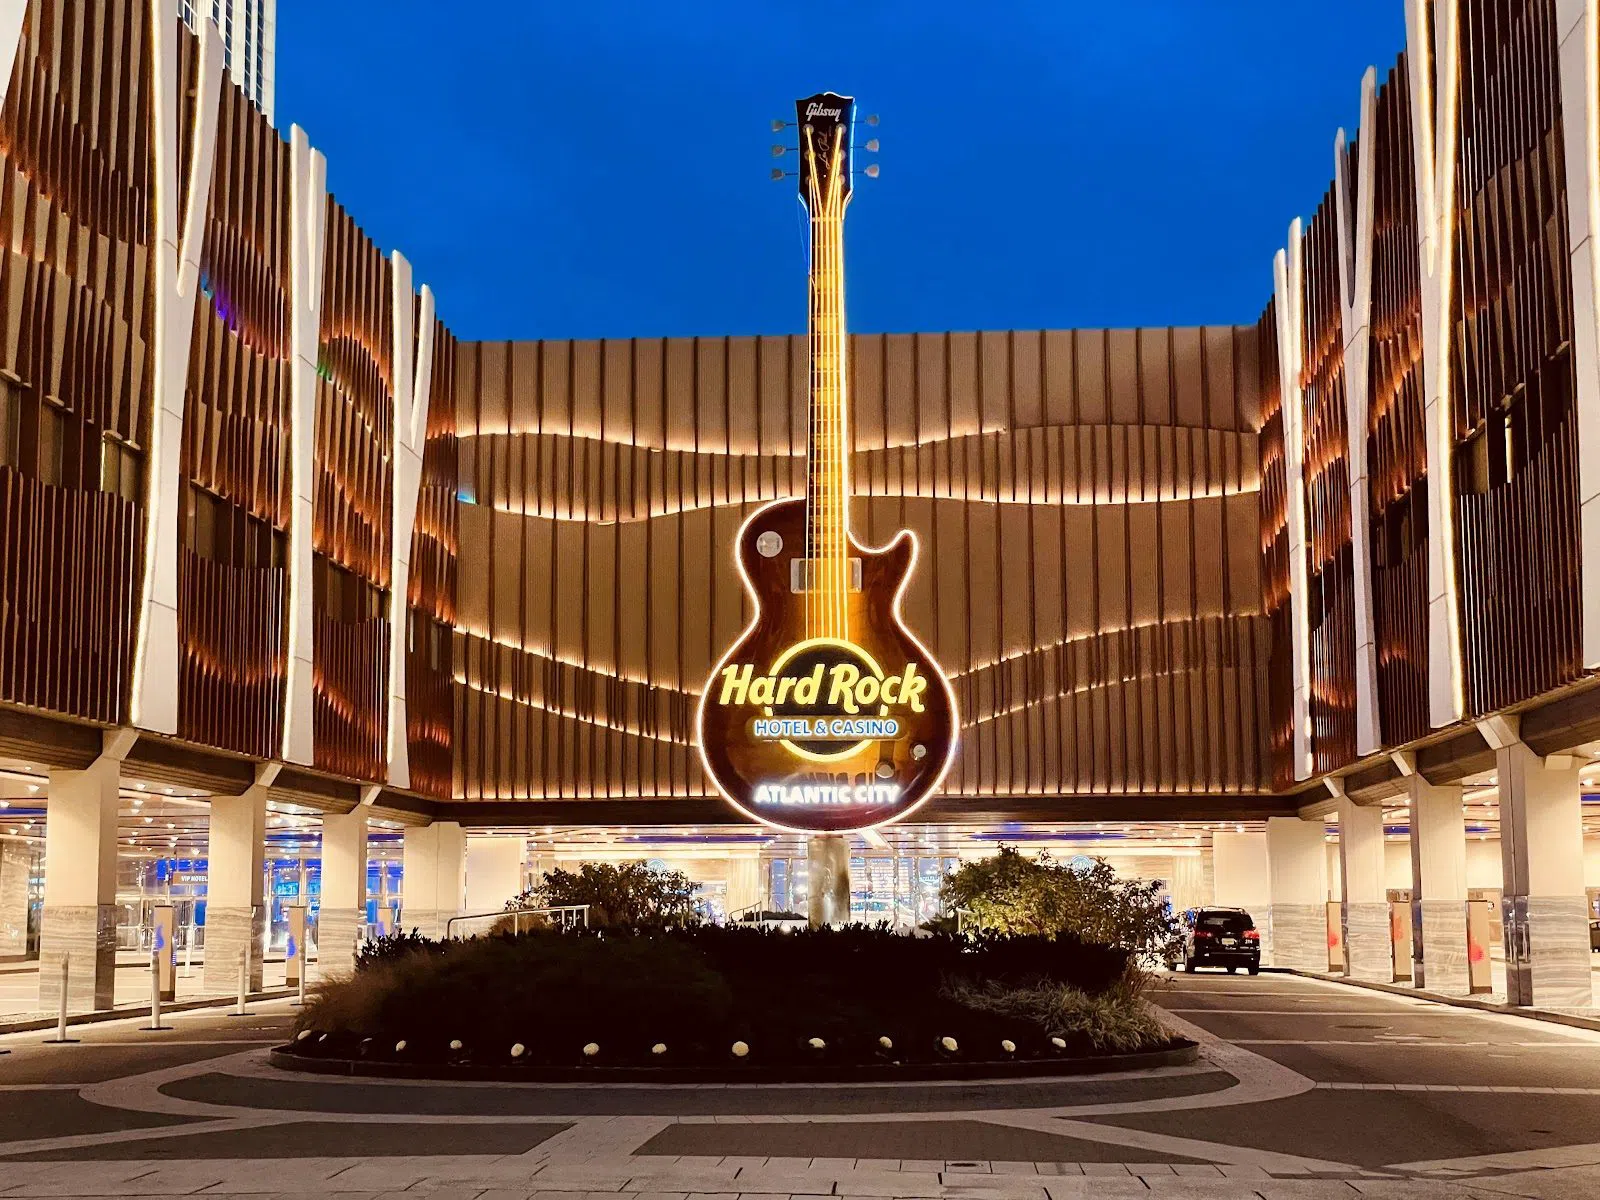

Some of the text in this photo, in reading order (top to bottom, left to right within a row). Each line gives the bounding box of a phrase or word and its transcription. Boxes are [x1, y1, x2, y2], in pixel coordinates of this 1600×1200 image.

[806, 103, 841, 122] Gibson
[719, 663, 927, 713] Hard Rock
[755, 720, 898, 736] HOTEL & CASINO
[754, 785, 900, 803] ATLANTIC CITY
